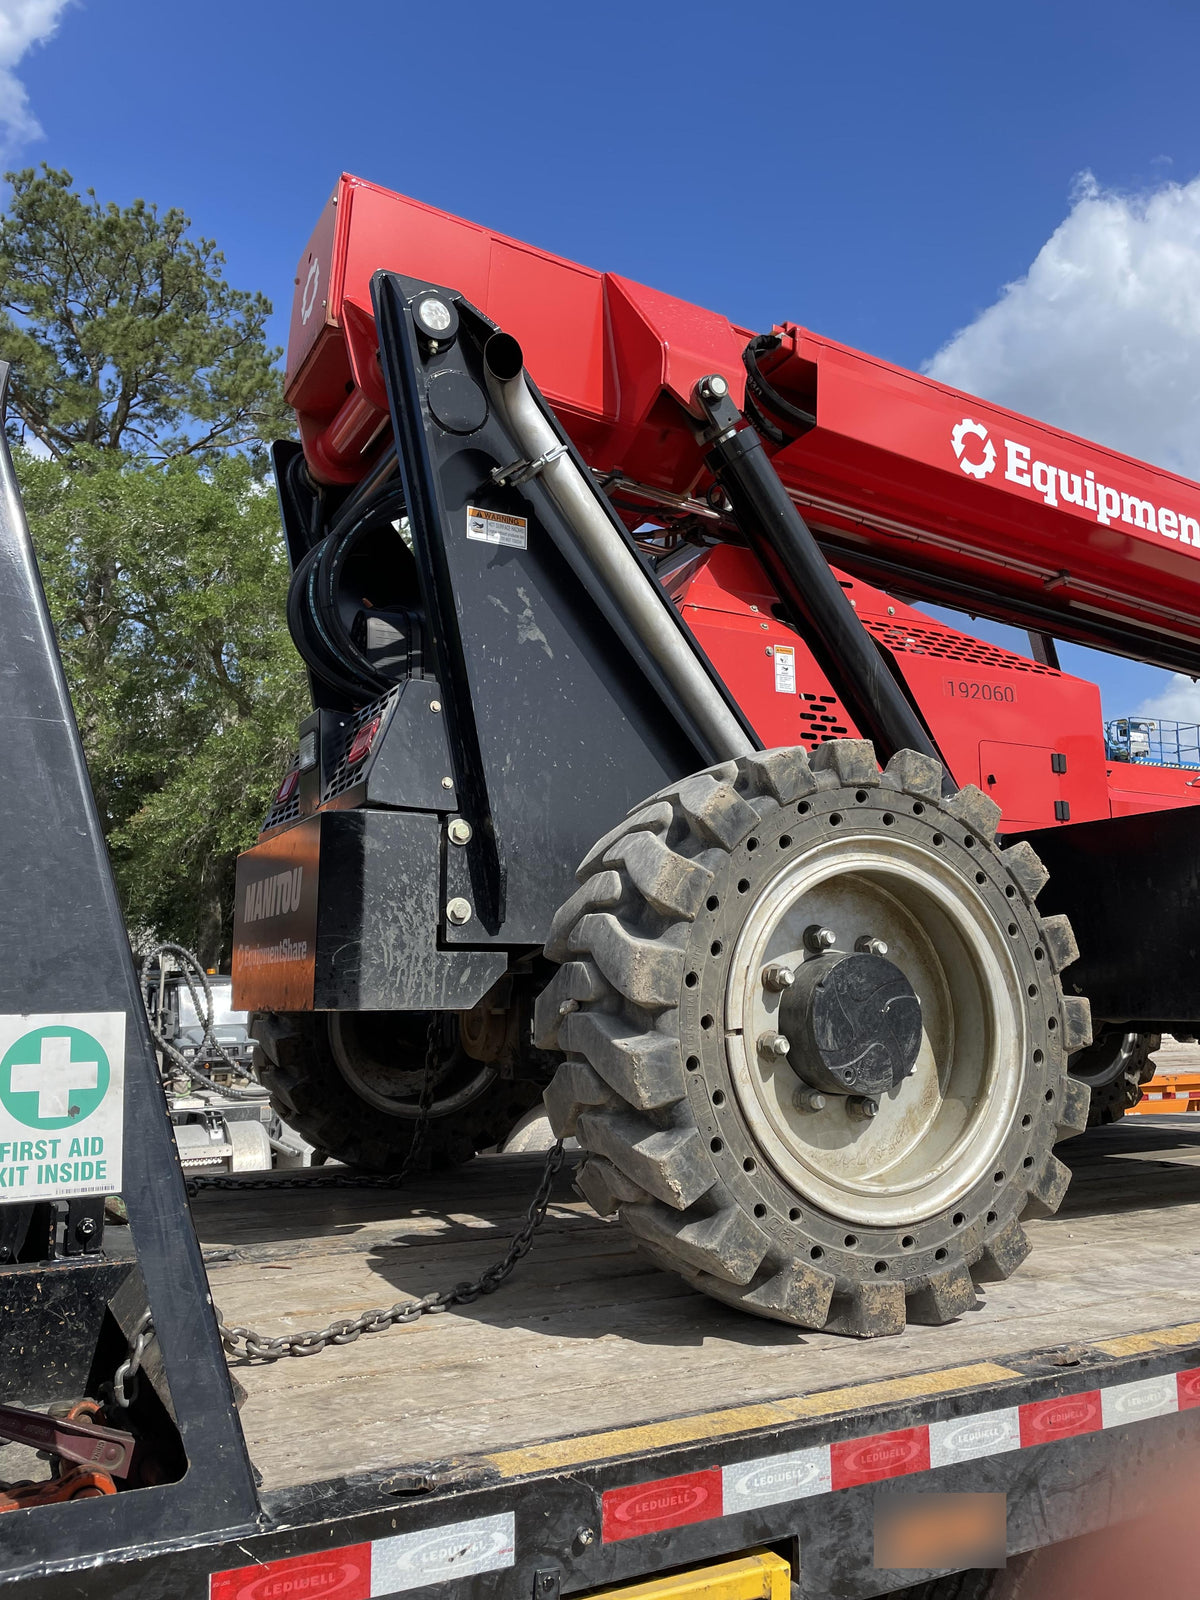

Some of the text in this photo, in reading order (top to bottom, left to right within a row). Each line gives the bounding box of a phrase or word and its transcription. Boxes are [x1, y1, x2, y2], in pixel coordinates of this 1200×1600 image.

[1004, 438, 1200, 548] Equipmen
[485, 512, 520, 525] WARNING
[947, 681, 1014, 702] 192060
[244, 866, 303, 923] MANITOU
[244, 938, 307, 969] EquipmentShare
[0, 1137, 104, 1162] FIRST AID
[37, 1160, 107, 1185] INSIDE
[1046, 1410, 1083, 1425] LEDWELL
[958, 1428, 1000, 1443] LEDWELL
[861, 1449, 906, 1465] LEDWELL
[754, 1468, 804, 1487] LEDWELL
[635, 1493, 690, 1514] LEDWELL
[422, 1540, 486, 1563] LEDWELL
[264, 1573, 336, 1597] LEDWELL
